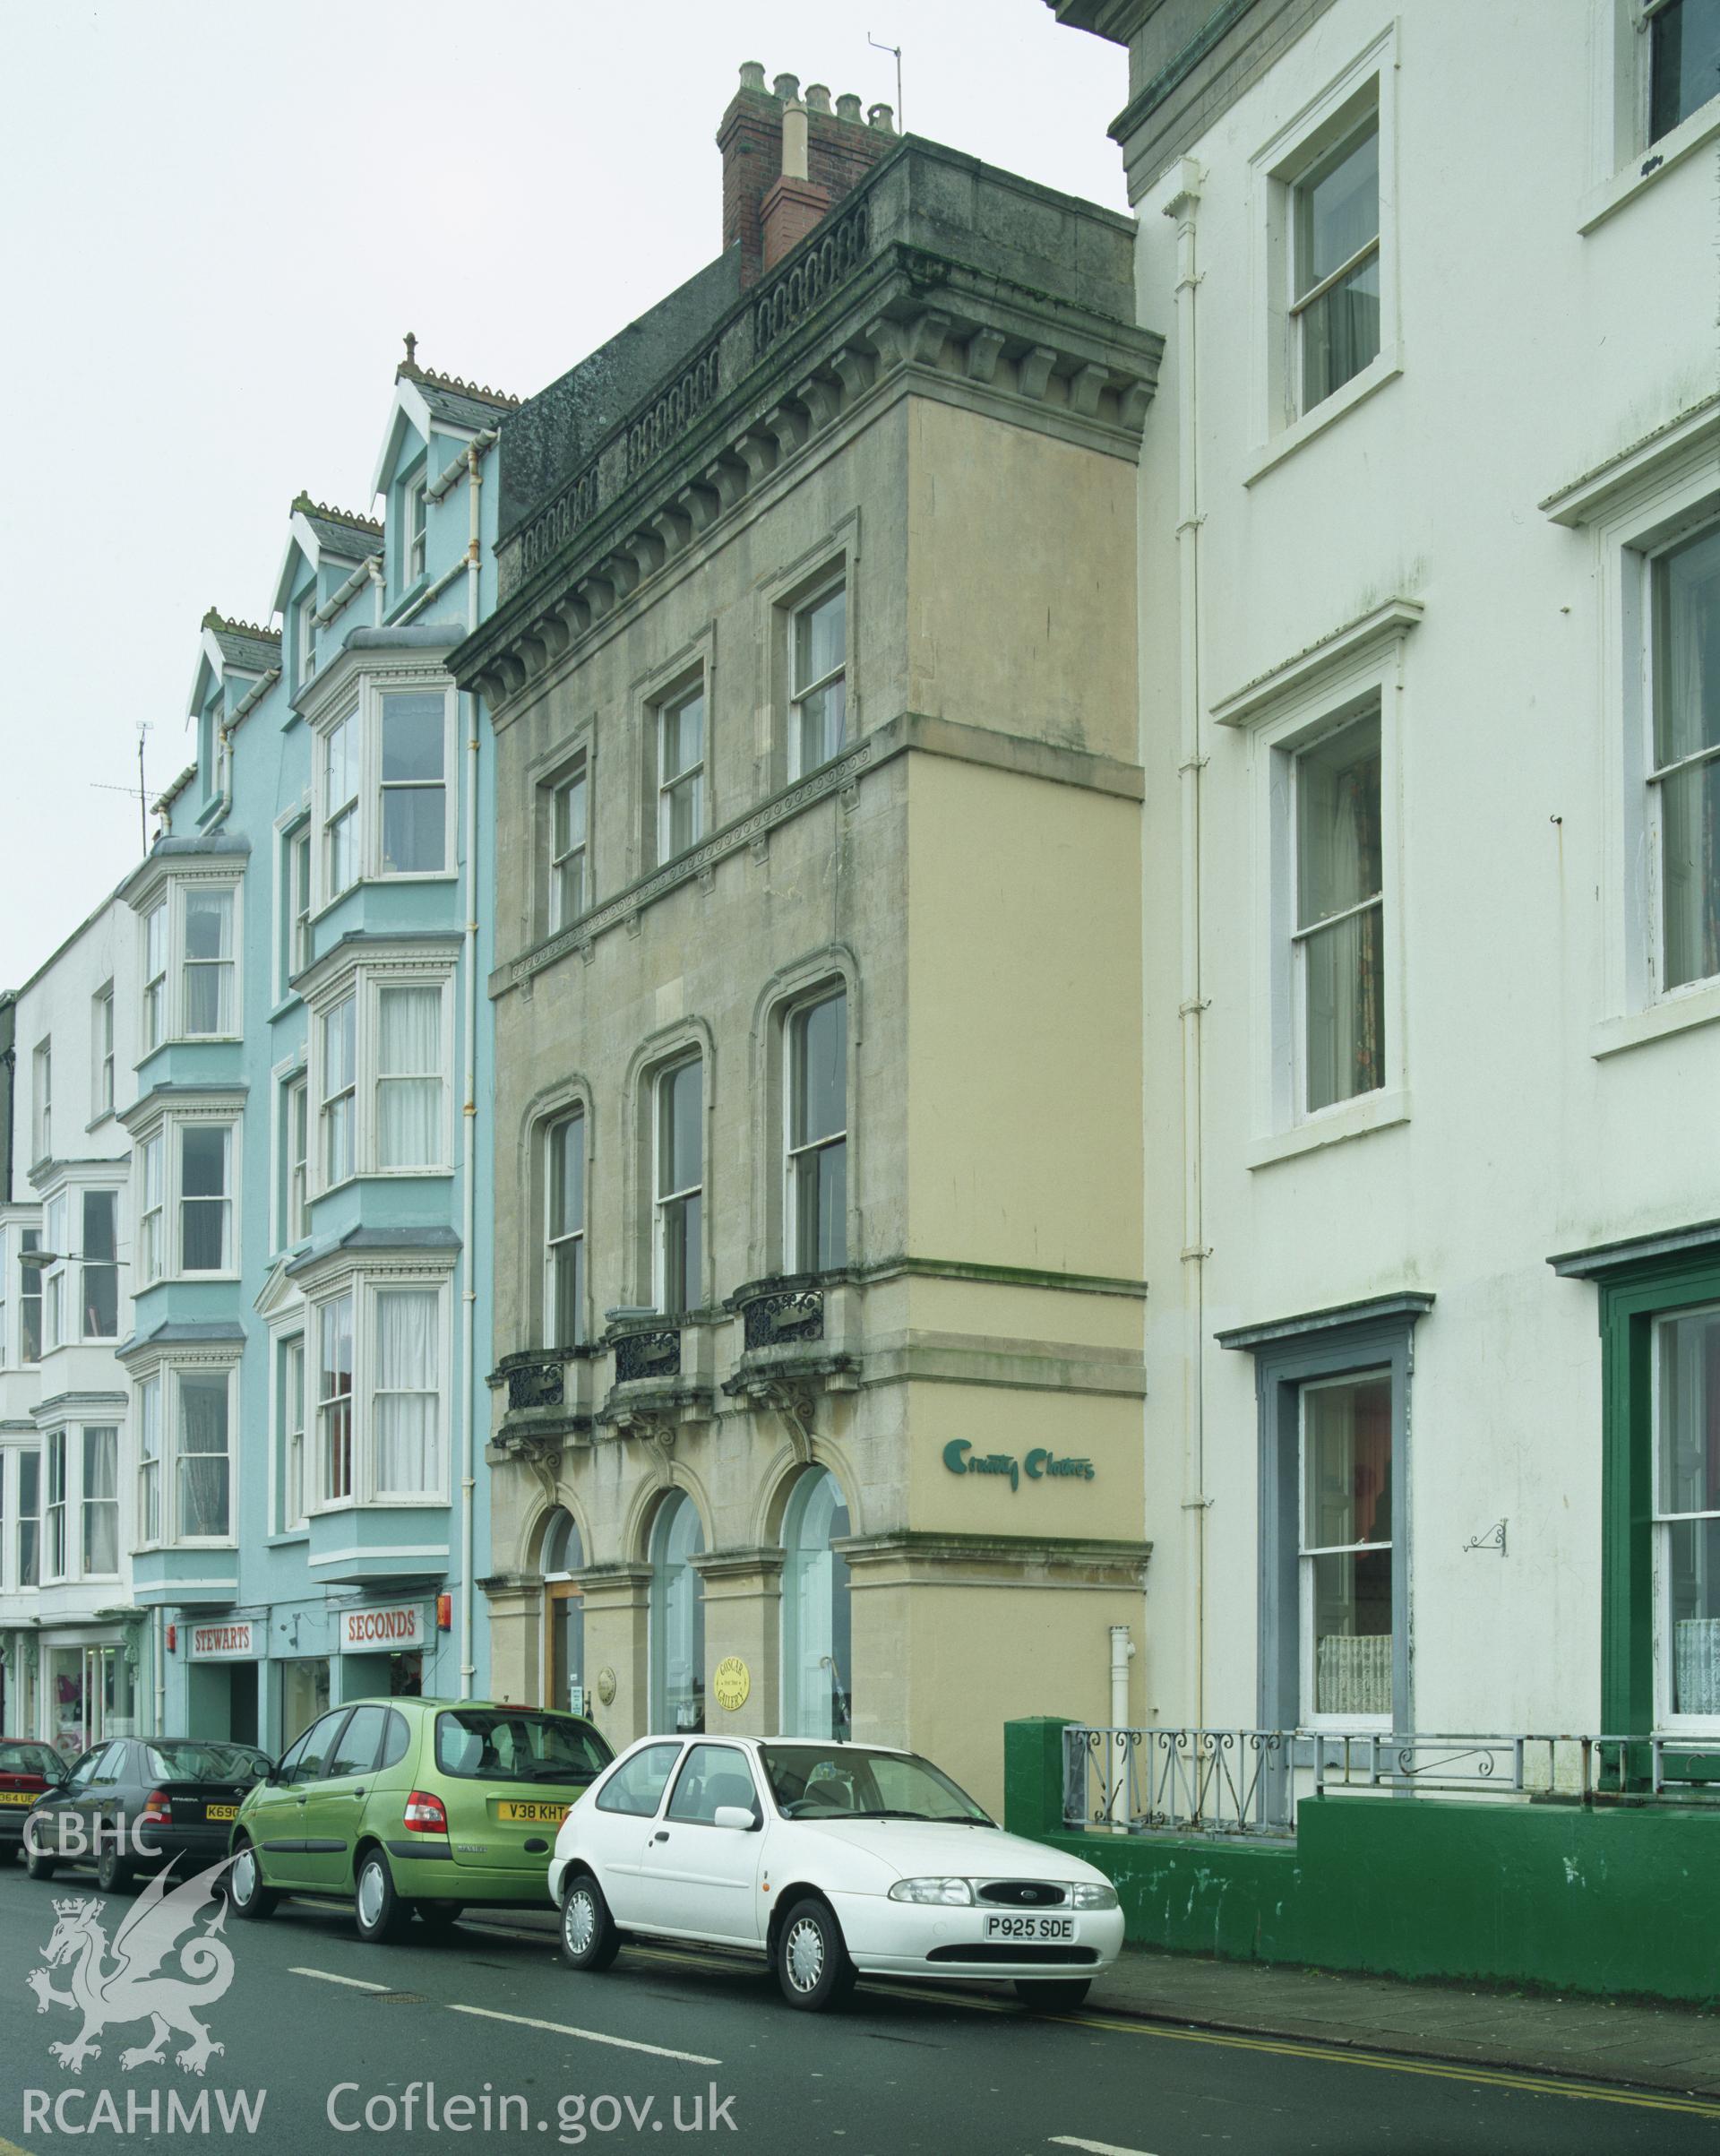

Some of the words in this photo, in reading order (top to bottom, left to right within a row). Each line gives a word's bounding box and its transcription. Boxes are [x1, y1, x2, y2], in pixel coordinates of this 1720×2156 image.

[348, 1609, 415, 1642] SECONDS
[195, 1626, 249, 1651] STEWARTS
[718, 1689, 744, 1709] GALLERY
[510, 1804, 536, 1819] V38
[539, 1805, 565, 1821] KHT
[988, 1918, 1036, 1936] P925
[1039, 1919, 1072, 1938] SDE
